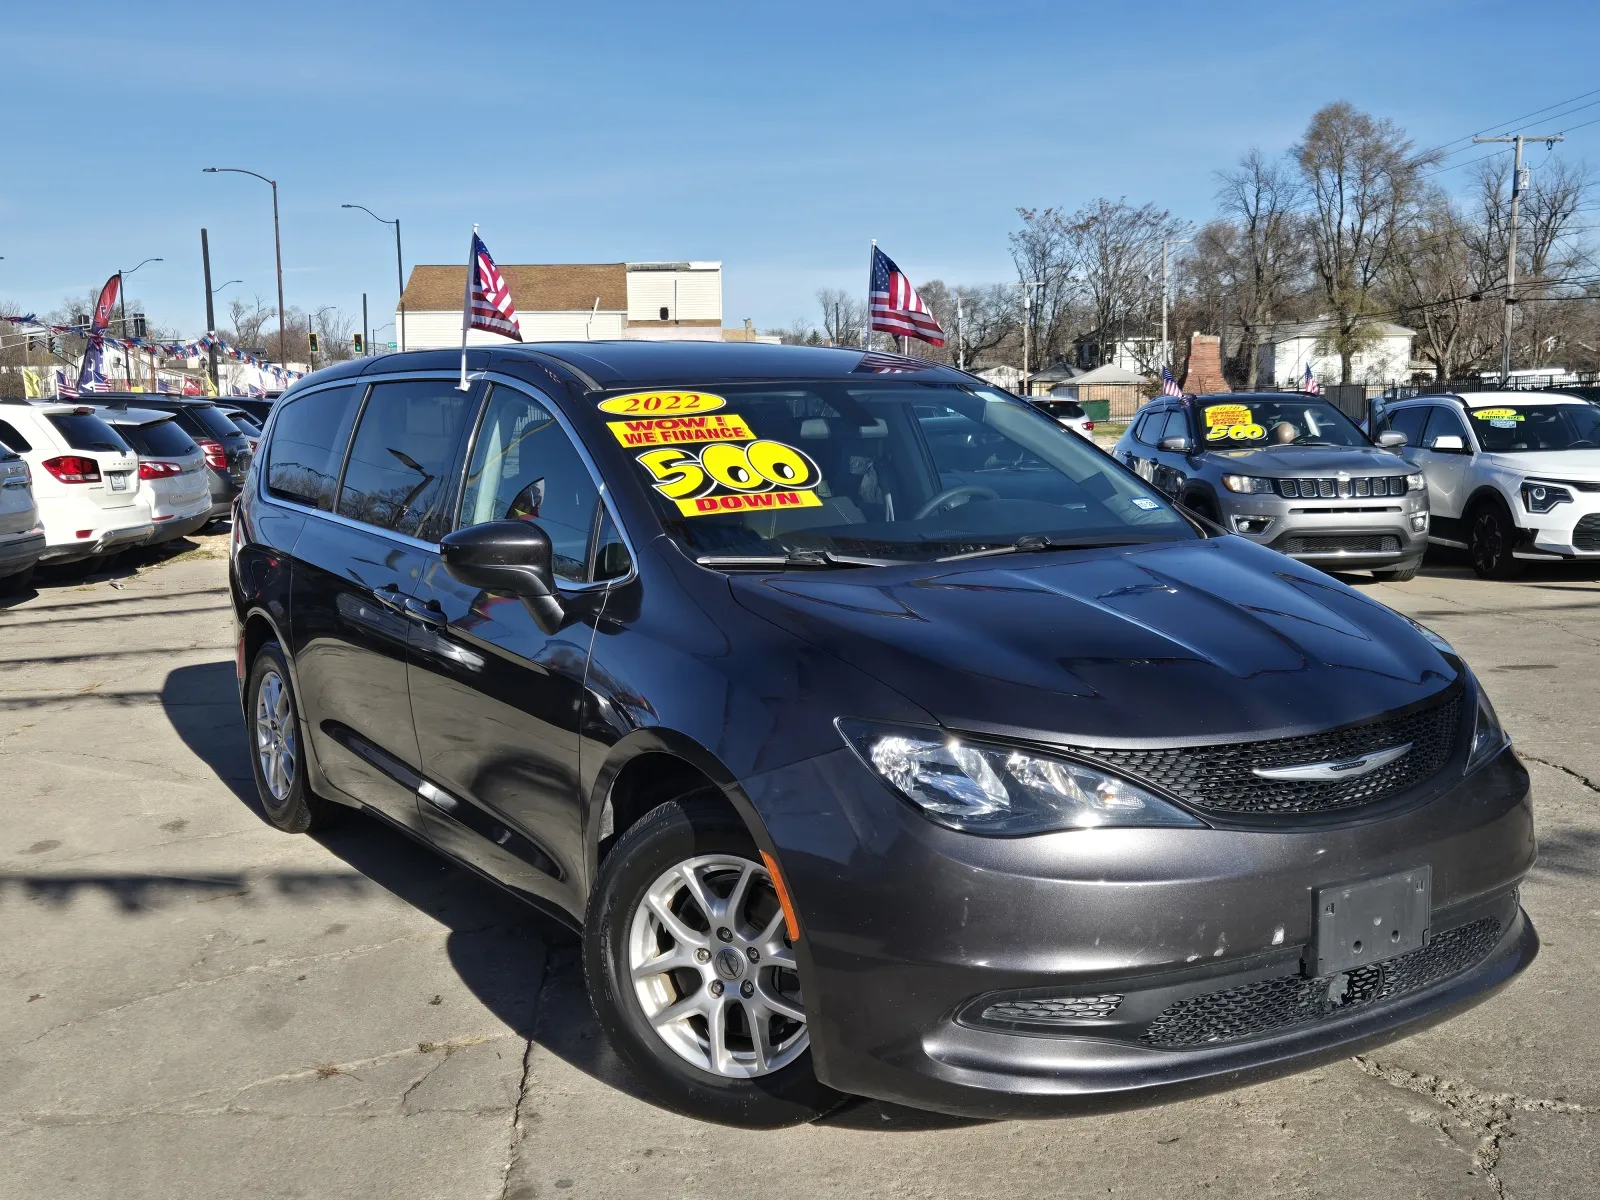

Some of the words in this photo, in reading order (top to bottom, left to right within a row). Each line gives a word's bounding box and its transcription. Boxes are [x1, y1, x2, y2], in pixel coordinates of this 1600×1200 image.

[623, 394, 701, 413] 2022
[624, 416, 709, 431] WOW
[716, 416, 726, 427] !
[1206, 424, 1268, 441] 500
[623, 431, 657, 445] WE
[662, 427, 746, 443] FINANCE
[636, 440, 822, 500] 500
[695, 492, 803, 512] DOWN
